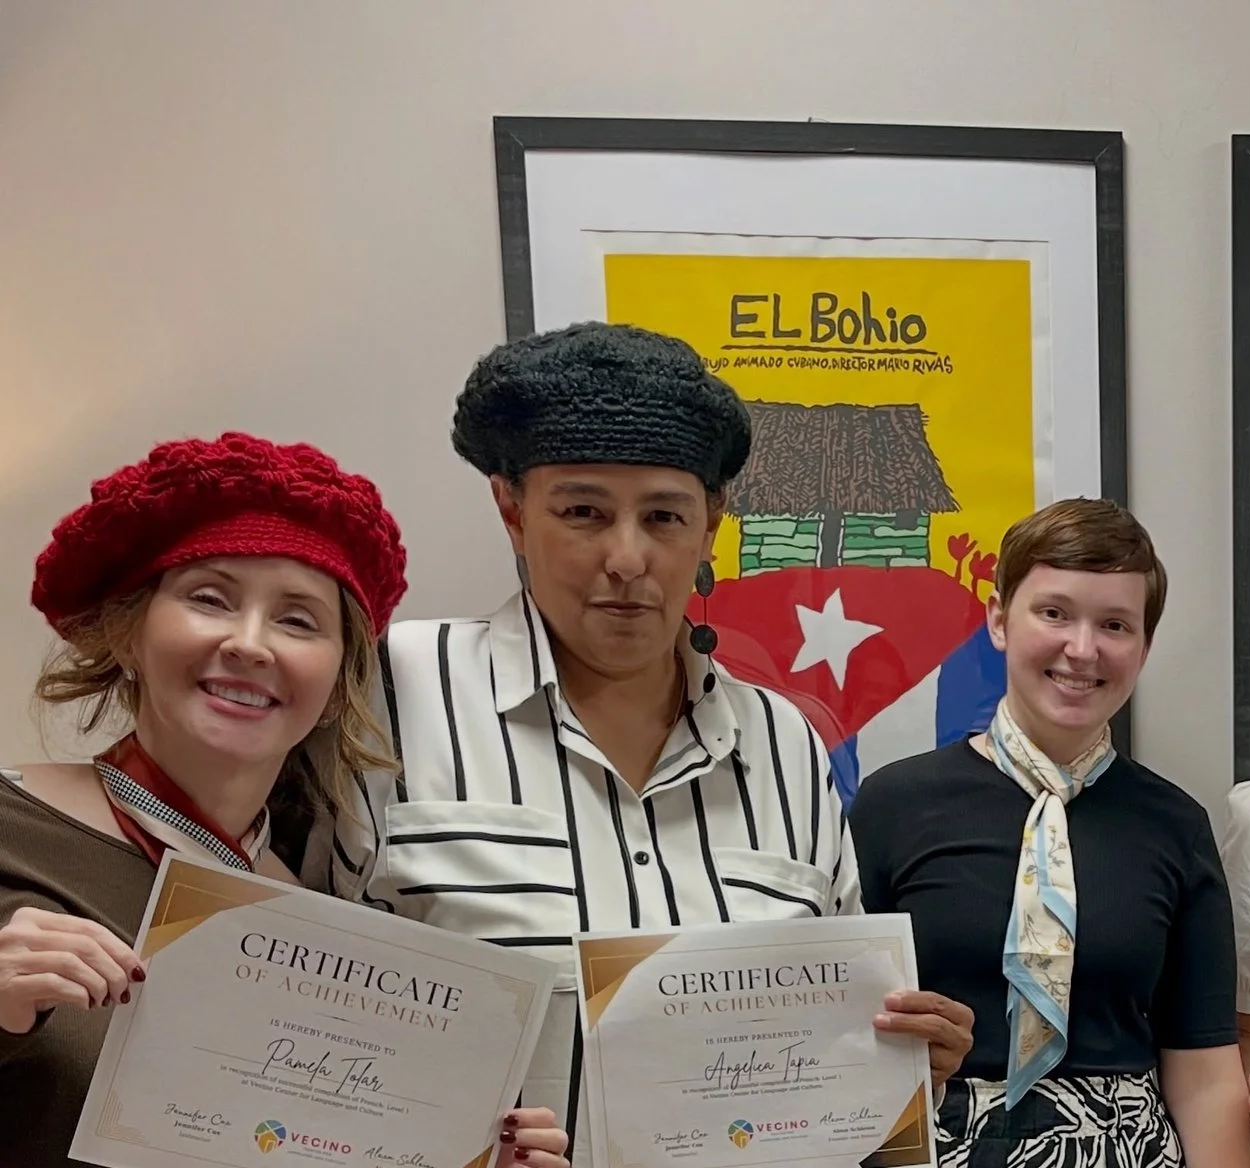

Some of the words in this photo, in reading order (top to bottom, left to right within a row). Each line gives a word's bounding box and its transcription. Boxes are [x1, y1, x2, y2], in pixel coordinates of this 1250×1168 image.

[730, 293, 802, 338] EL
[810, 291, 927, 346] Bohio
[702, 357, 729, 373] BUJO
[733, 356, 783, 368] ANIMADO
[877, 357, 909, 372] MARIO
[912, 355, 953, 375] RIVAS
[240, 932, 463, 1012] CERTIFICATE
[658, 961, 850, 997] CERTIFICATE
[236, 964, 268, 983] OF
[278, 976, 452, 1033] ACHIEVEMENT
[663, 1002, 690, 1016] OF
[701, 989, 849, 1013] ACHIEVEMENT
[283, 1021, 322, 1038] HEREBY
[324, 1032, 381, 1053] PRESENTED
[384, 1047, 396, 1056] TO
[717, 1035, 748, 1044] HEREBY
[752, 1031, 799, 1041] PRESENTED
[262, 1038, 332, 1084] Pamela
[336, 1057, 383, 1094] Tolar
[705, 1050, 775, 1090] Angelica
[778, 1041, 820, 1082] Tapia
[291, 1132, 352, 1154] VECINO
[756, 1119, 809, 1133] VECINO
